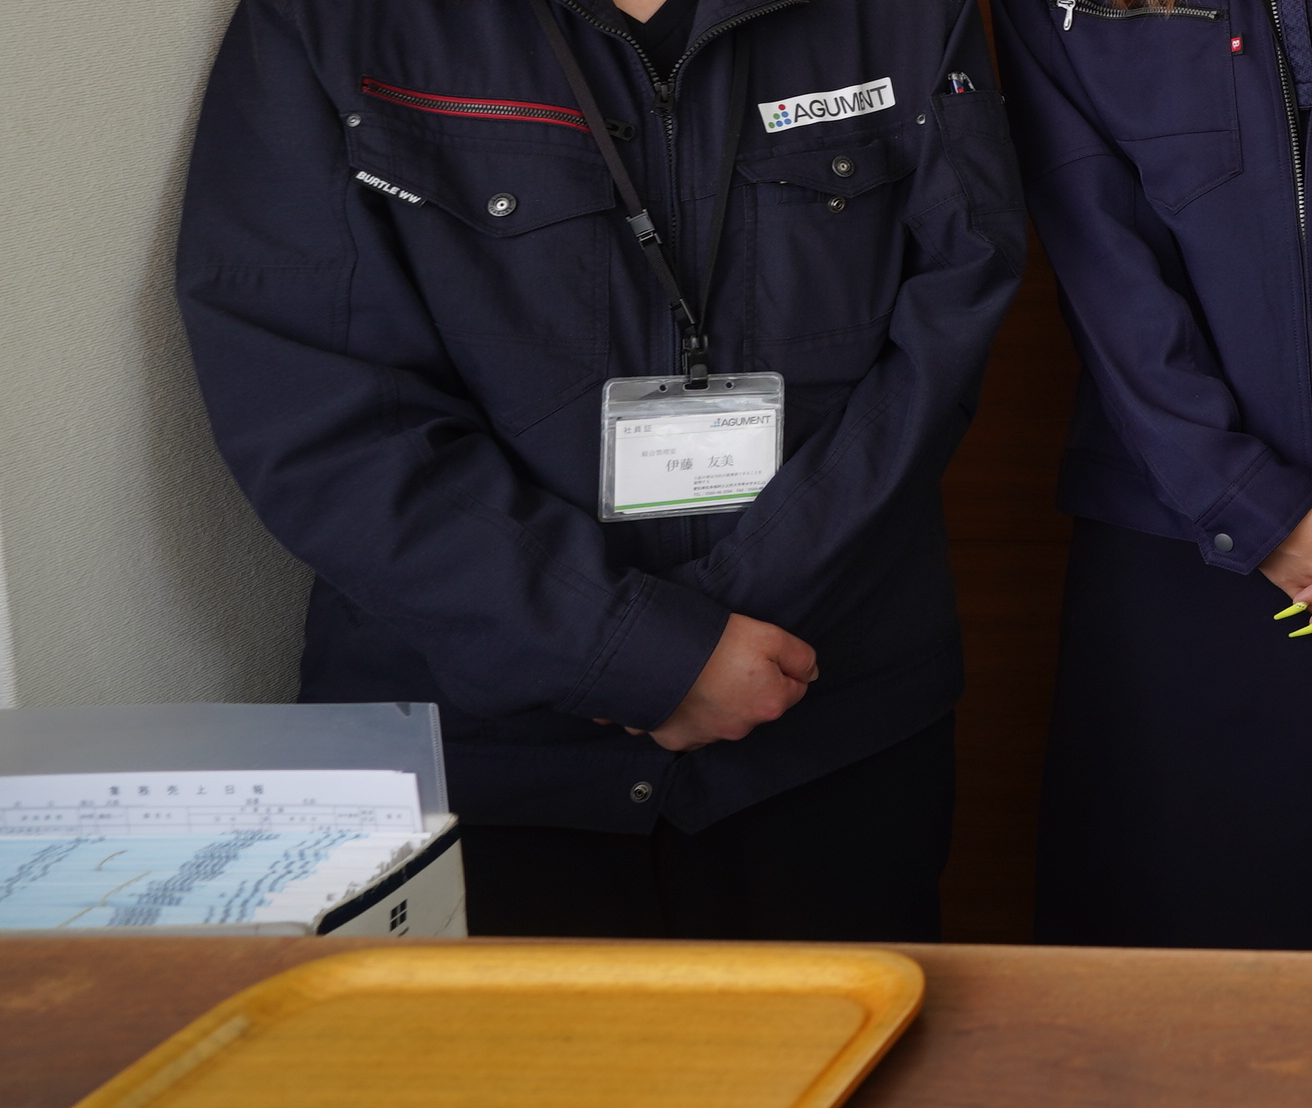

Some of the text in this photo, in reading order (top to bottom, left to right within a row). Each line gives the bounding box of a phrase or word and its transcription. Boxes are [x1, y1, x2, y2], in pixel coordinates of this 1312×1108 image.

[355, 170, 422, 204] BURTLE WW
[720, 415, 772, 427] AGUMENT
[666, 454, 735, 473] 伊藤 友美
